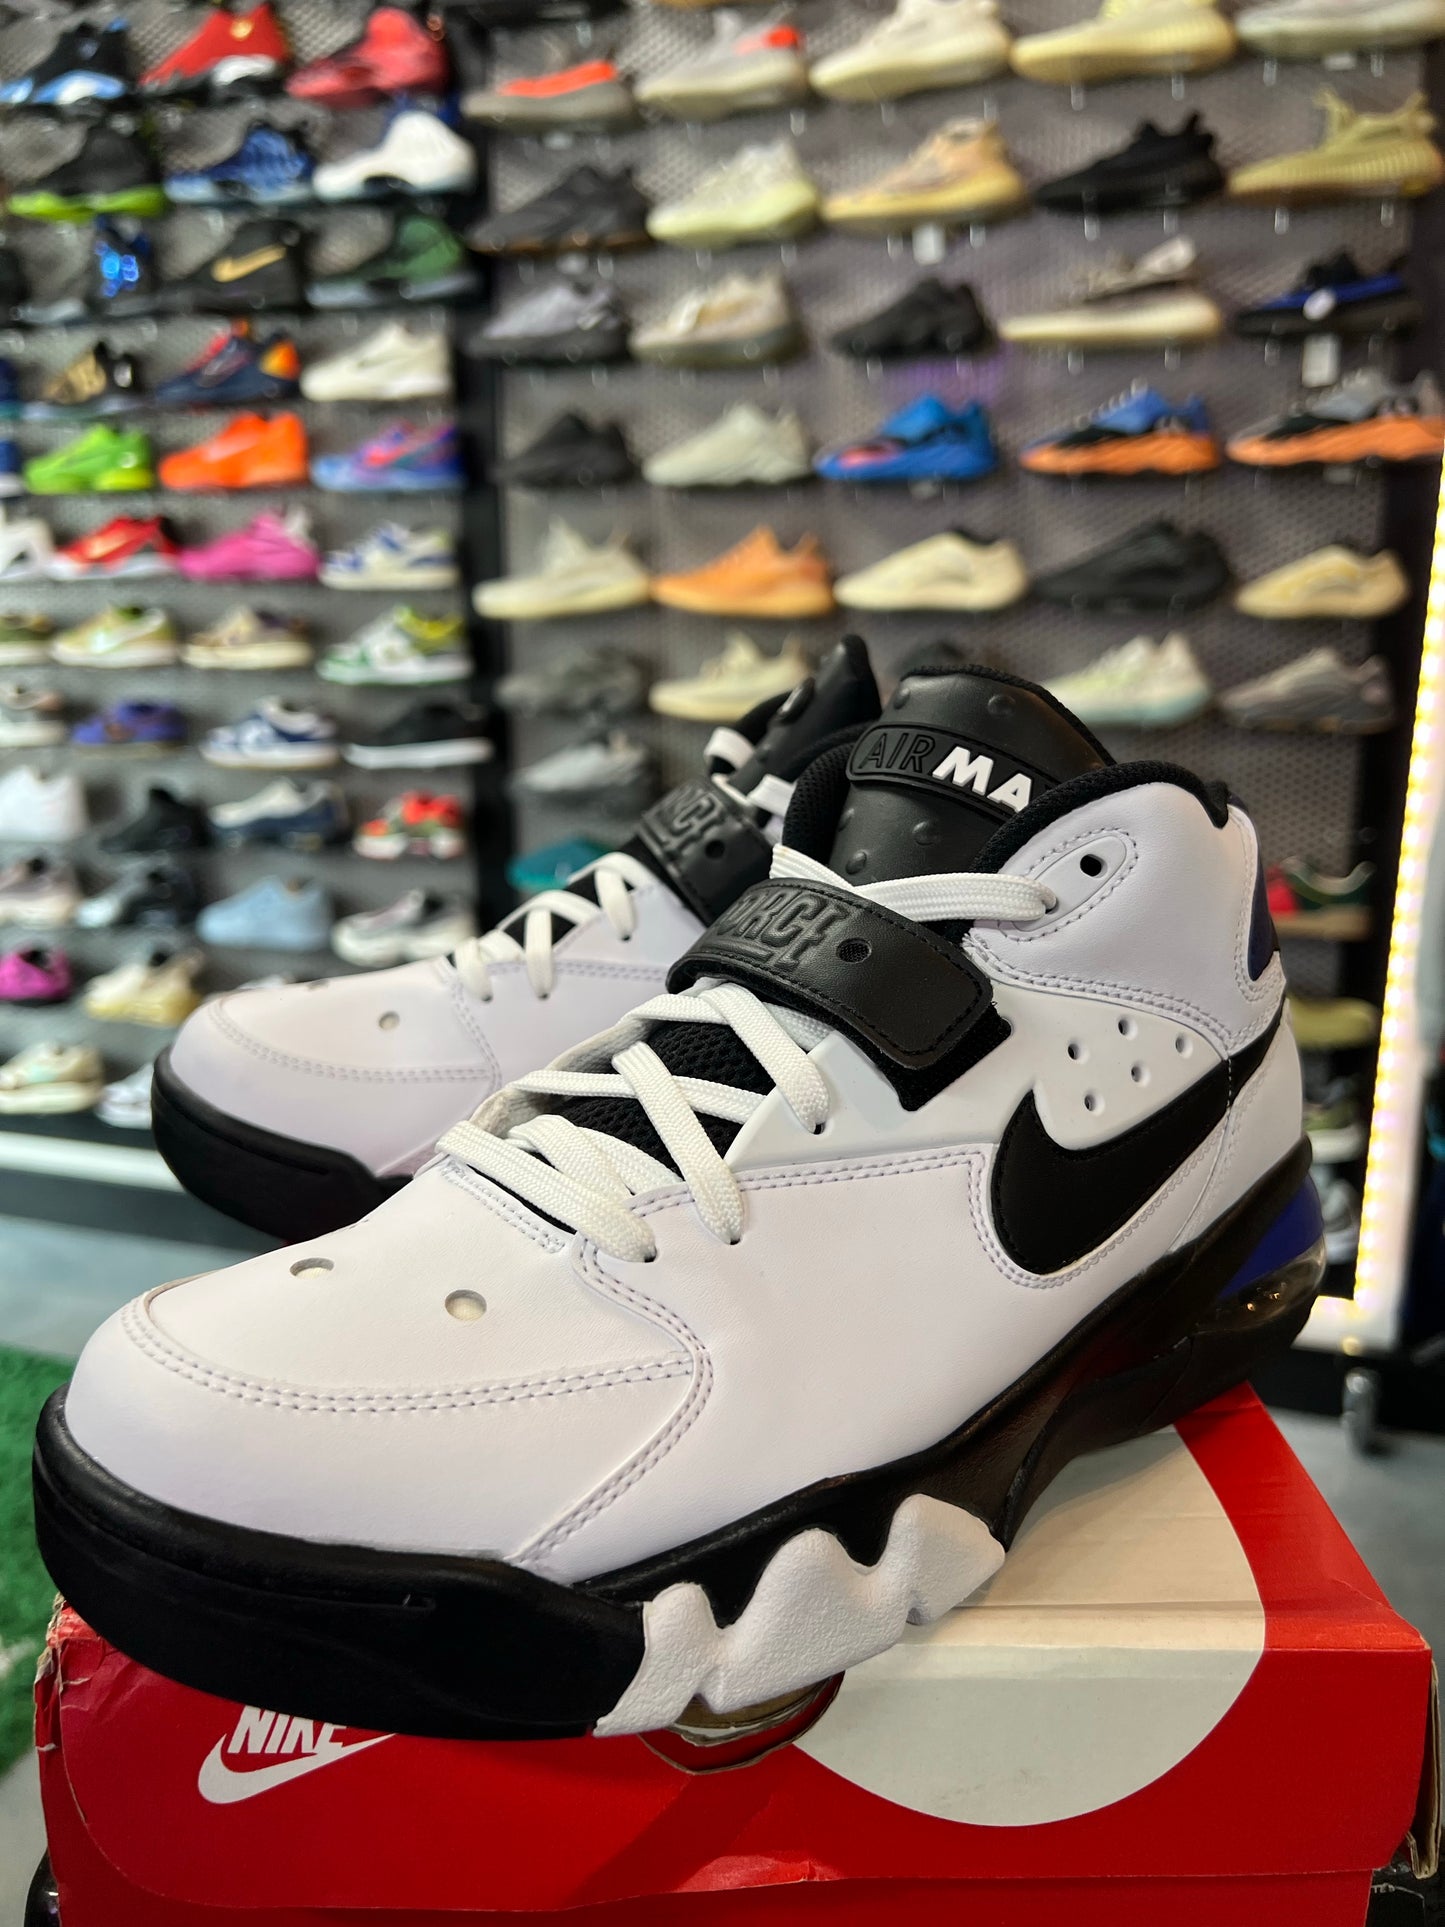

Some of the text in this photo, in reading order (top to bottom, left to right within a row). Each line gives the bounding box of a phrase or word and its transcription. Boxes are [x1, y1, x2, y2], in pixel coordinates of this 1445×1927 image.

[858, 732, 1034, 814] AIR MA
[227, 1705, 347, 1754] NIKE
